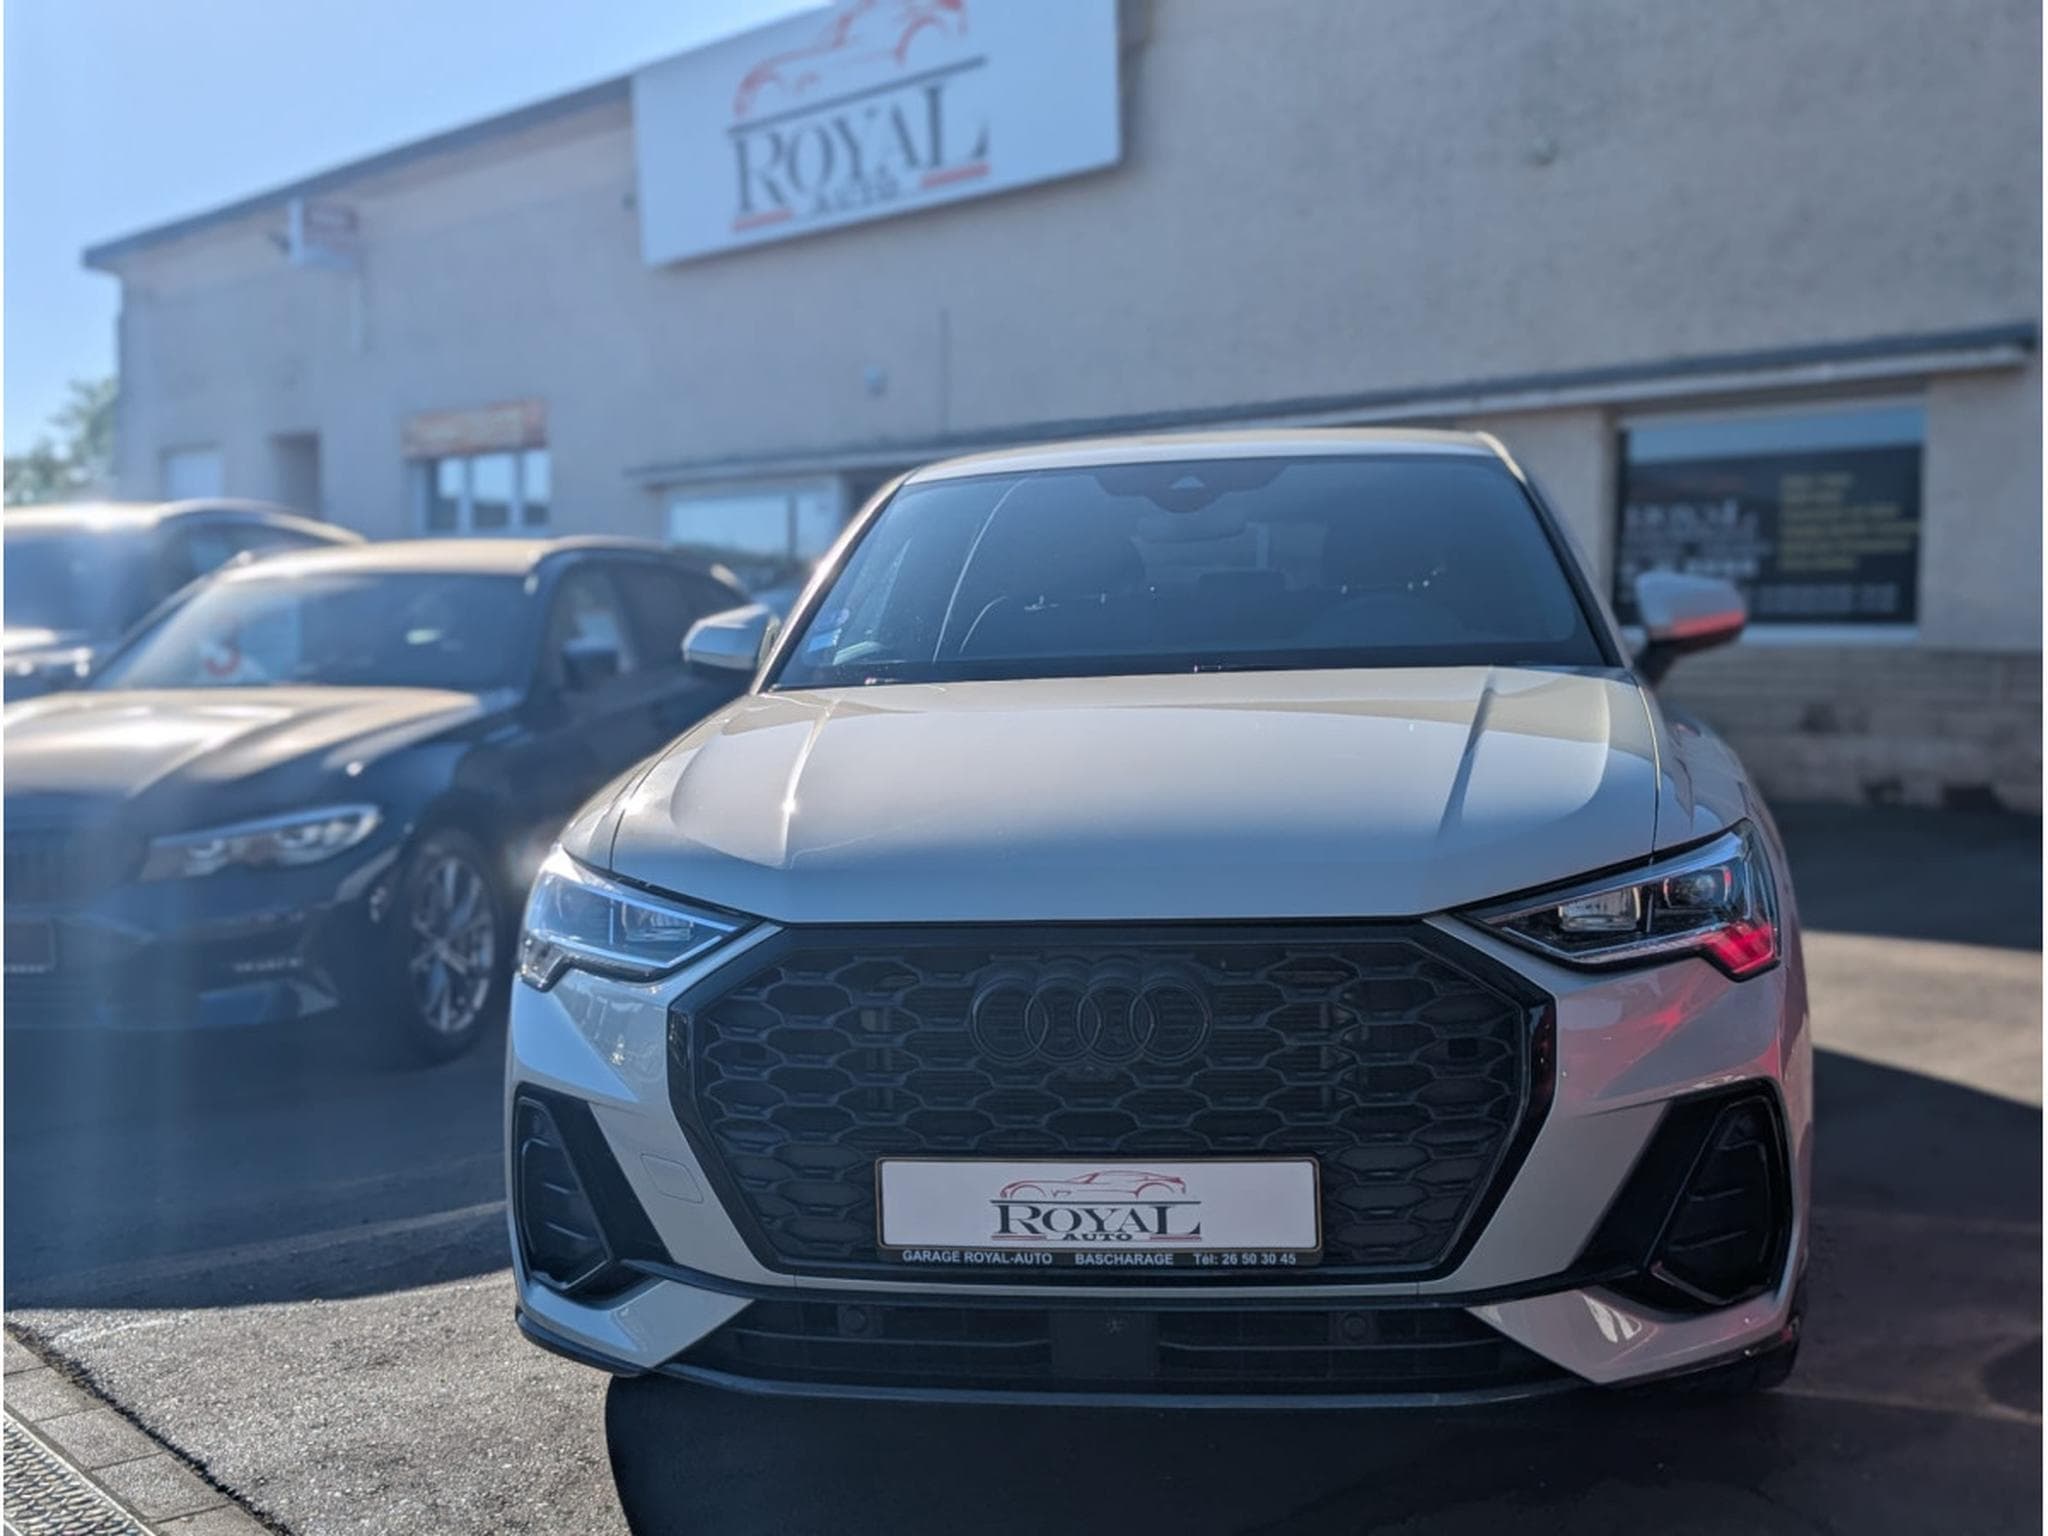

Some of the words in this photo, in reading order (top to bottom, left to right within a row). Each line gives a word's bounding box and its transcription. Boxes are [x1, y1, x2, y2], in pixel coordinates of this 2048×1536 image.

[732, 84, 991, 214] ROYAL
[996, 1204, 1202, 1236] ROYAL
[1062, 1232, 1134, 1242] AUTO
[902, 1250, 961, 1264] GARAGE
[963, 1252, 1053, 1265] ROYAL-AUTO
[1074, 1253, 1174, 1266] BASCHARAGE
[1221, 1253, 1238, 1266] 26
[1241, 1253, 1258, 1266] 50
[1260, 1253, 1277, 1266] 30
[1279, 1253, 1297, 1266] 45
